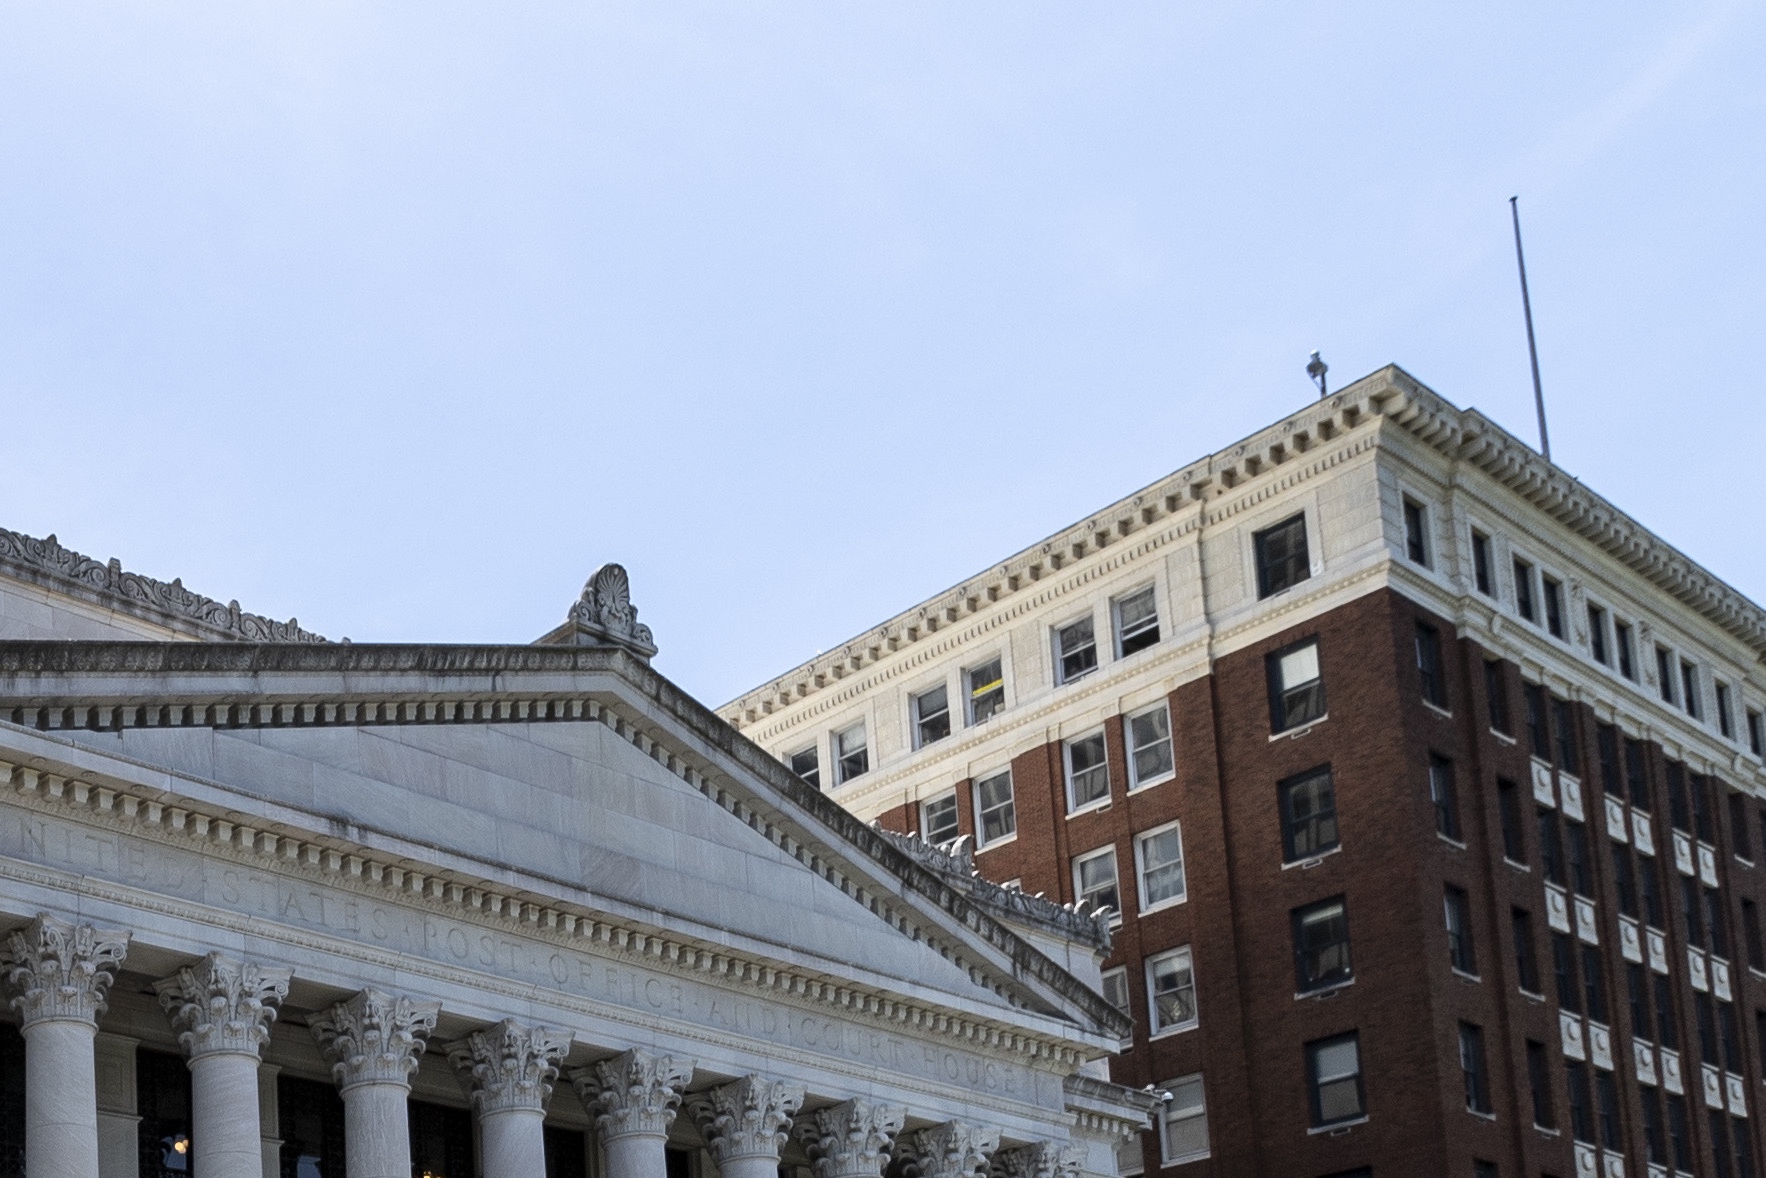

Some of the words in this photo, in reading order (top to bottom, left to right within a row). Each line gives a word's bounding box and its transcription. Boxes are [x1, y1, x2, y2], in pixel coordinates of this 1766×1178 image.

[221, 869, 389, 940] STATES
[421, 912, 524, 974] POST
[548, 953, 683, 1014] OFFICE
[800, 1017, 903, 1065] COURT
[922, 1047, 1016, 1094] HOUSE
